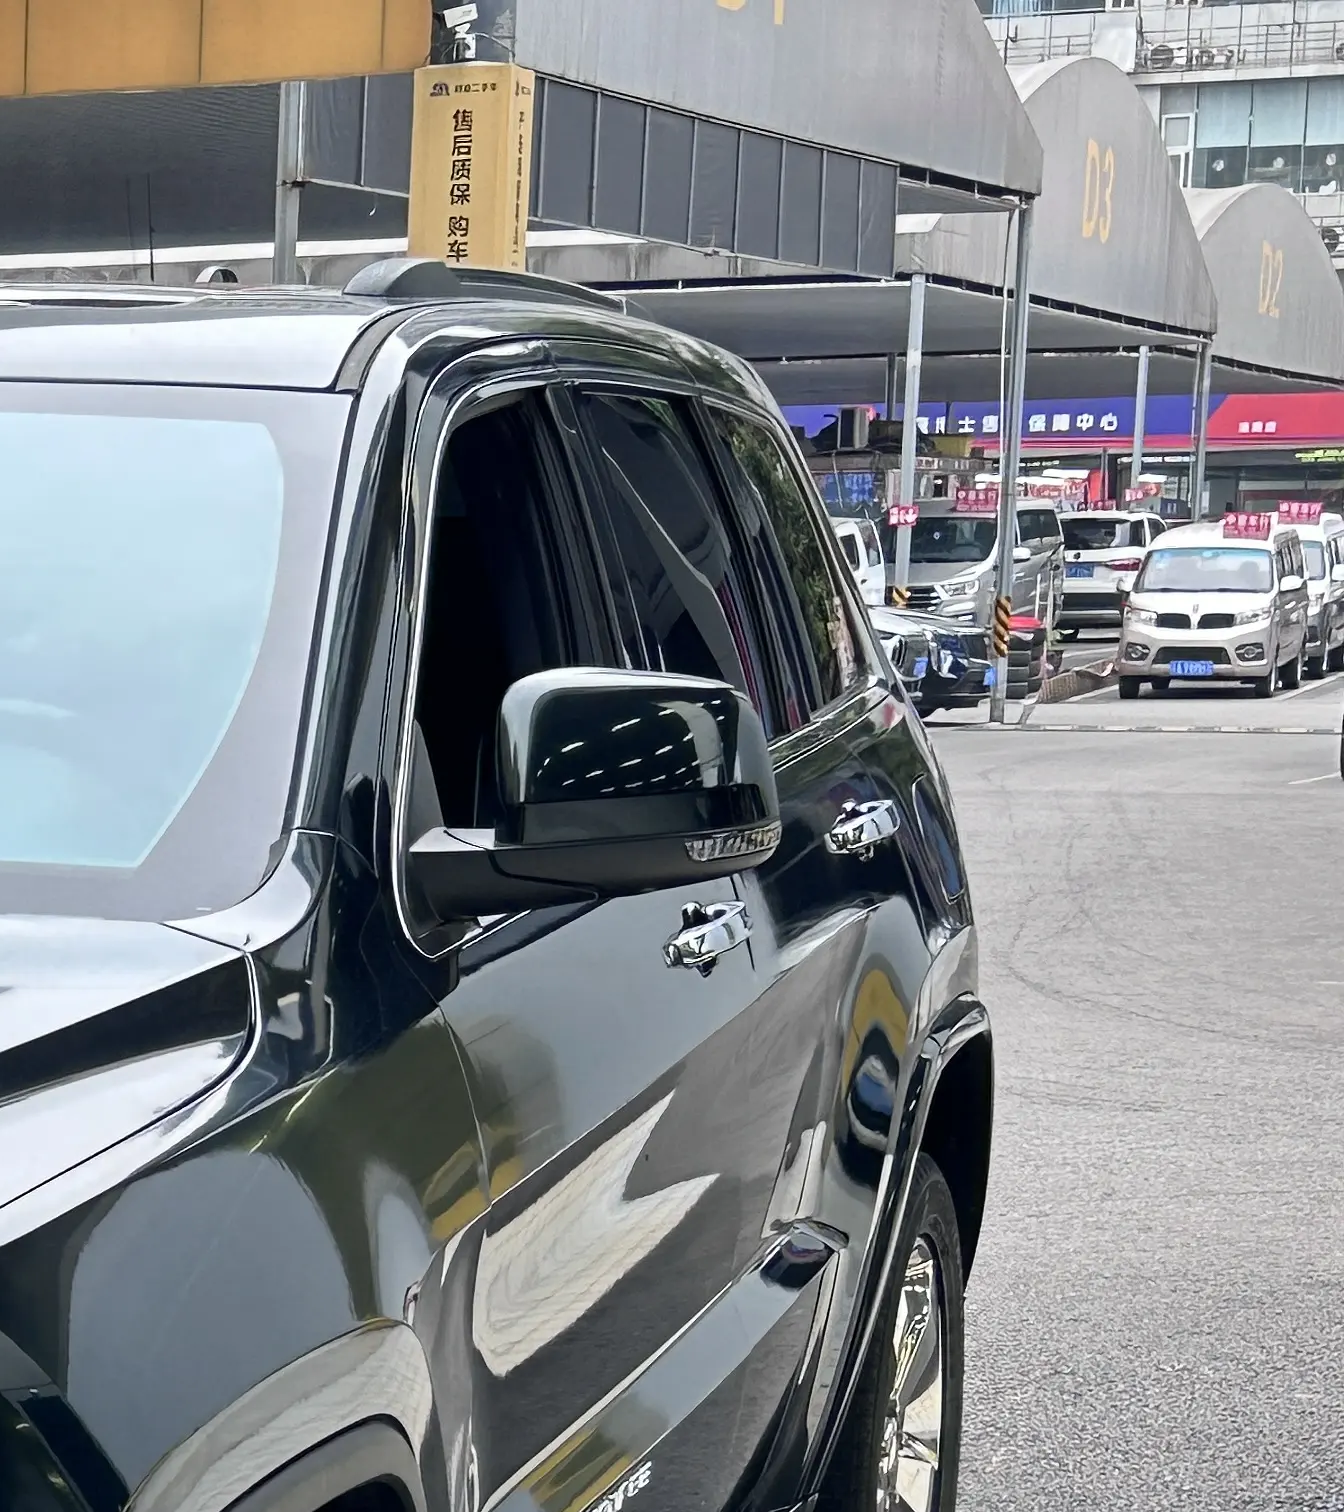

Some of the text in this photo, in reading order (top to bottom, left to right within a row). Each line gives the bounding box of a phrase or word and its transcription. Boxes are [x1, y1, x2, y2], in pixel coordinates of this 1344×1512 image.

[446, 108, 473, 263] 售后质保 购车
[1082, 138, 1115, 244] D3
[1258, 240, 1284, 319] D2
